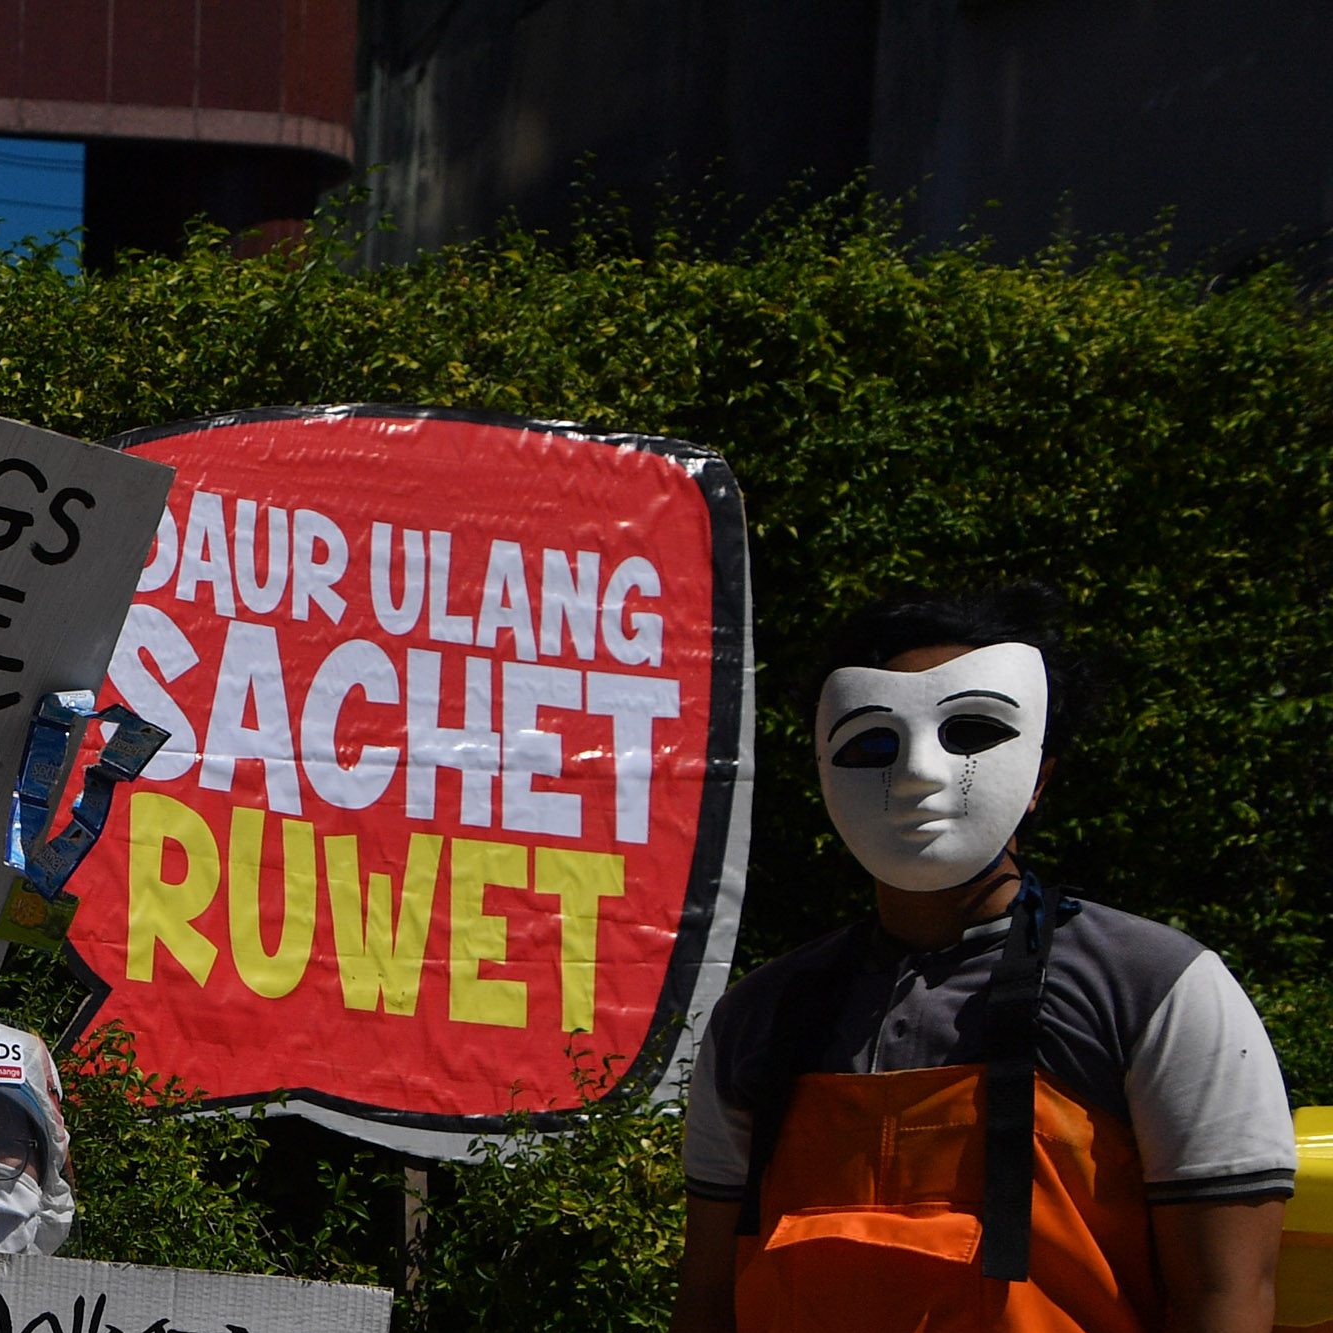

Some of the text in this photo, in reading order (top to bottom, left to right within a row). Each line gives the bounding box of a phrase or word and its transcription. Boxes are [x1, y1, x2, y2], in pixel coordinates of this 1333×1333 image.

[370, 522, 663, 668] ULANG
[101, 604, 679, 844] SACHET
[125, 791, 624, 1034] RUWET
